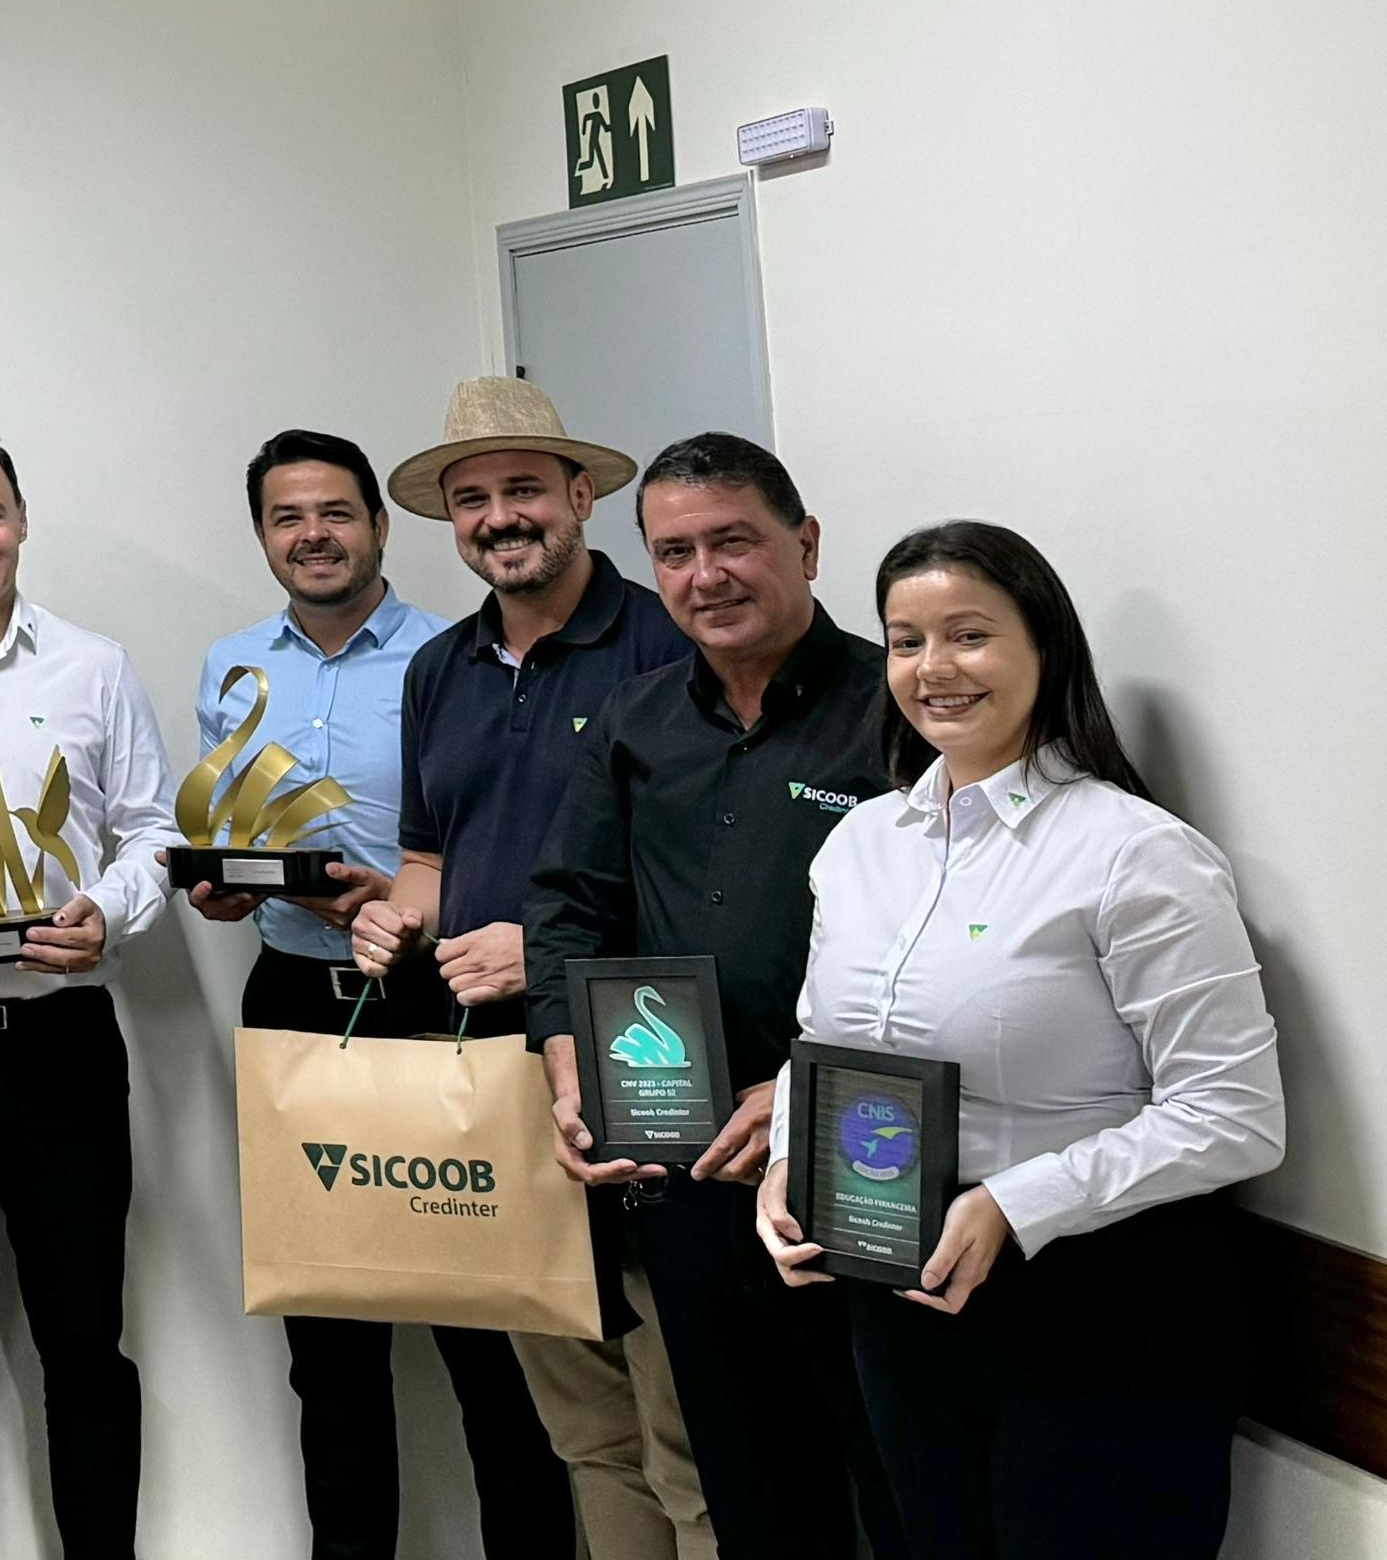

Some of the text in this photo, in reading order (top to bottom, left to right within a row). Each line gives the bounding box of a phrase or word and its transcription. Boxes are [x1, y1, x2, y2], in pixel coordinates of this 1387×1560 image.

[802, 786, 858, 808] SICOOB
[857, 1102, 895, 1121] CNIS
[349, 1153, 495, 1193] SICOOB
[409, 1196, 498, 1217] Credinter
[835, 1192, 873, 1206] EDUCAÇÃO
